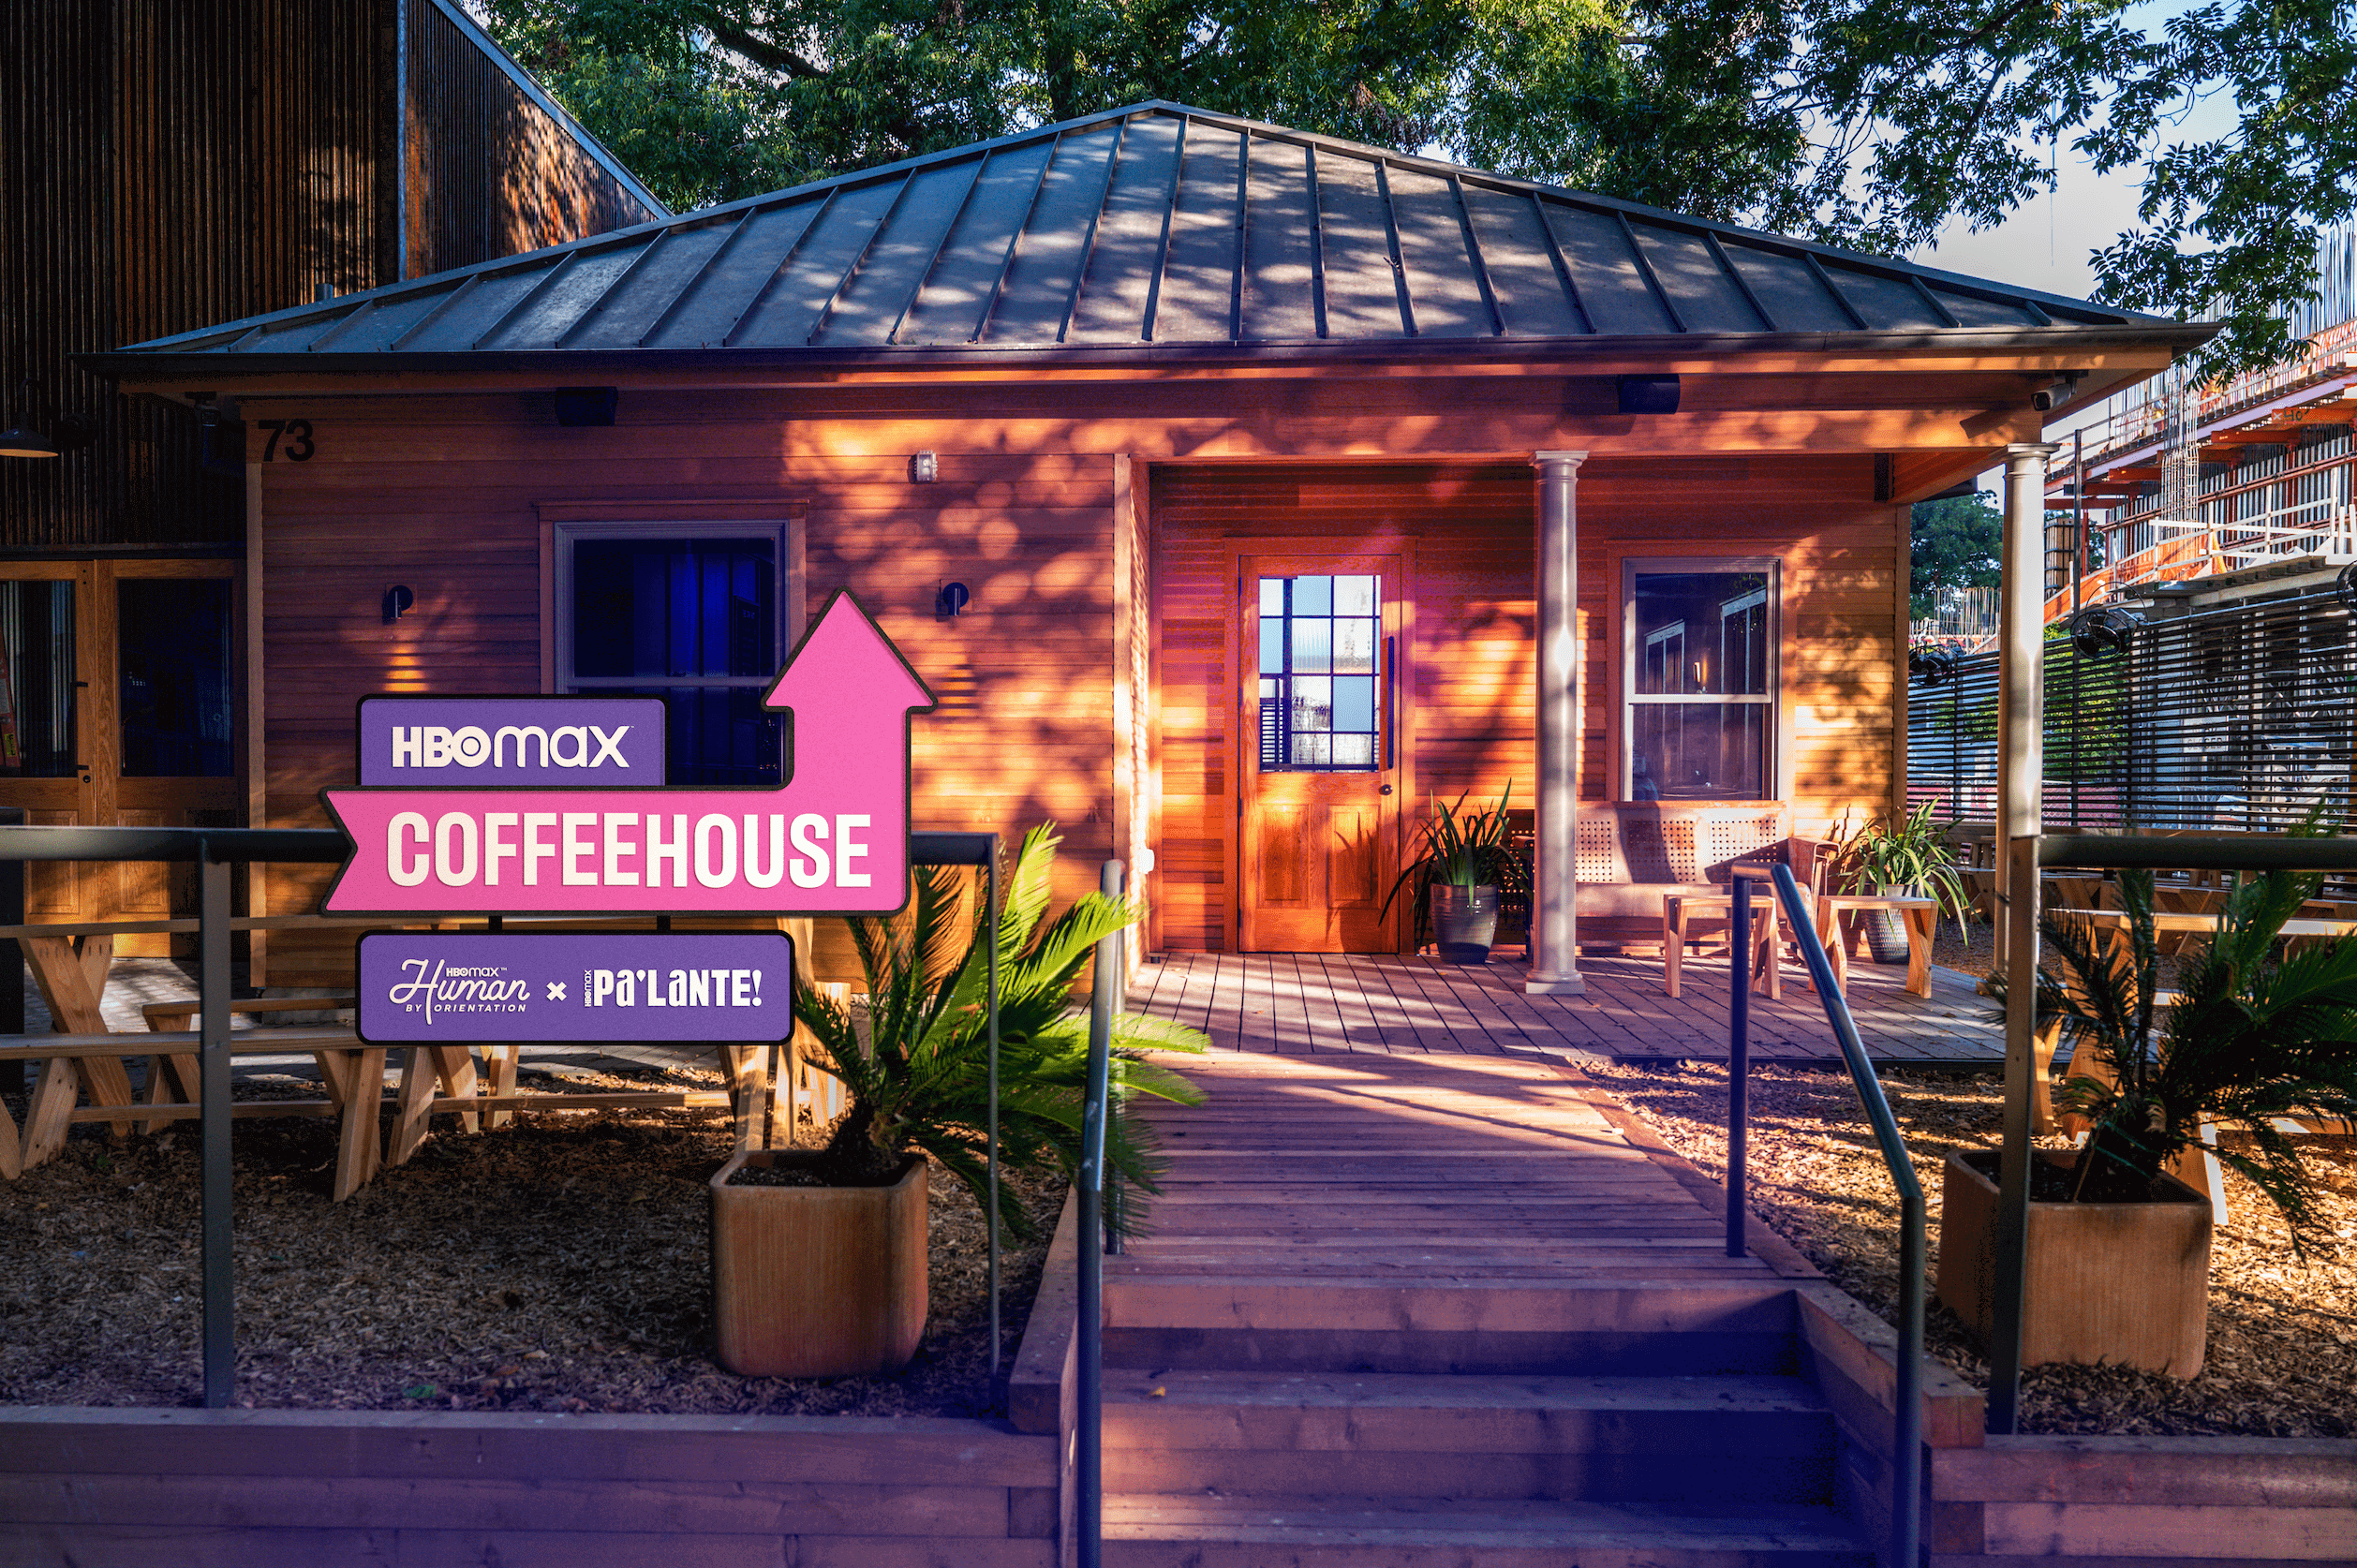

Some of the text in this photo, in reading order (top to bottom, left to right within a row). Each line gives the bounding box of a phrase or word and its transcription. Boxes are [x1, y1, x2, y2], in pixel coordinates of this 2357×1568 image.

[258, 419, 315, 462] 73
[387, 811, 871, 888] COFFEEHOUSE
[389, 958, 531, 1026] Human
